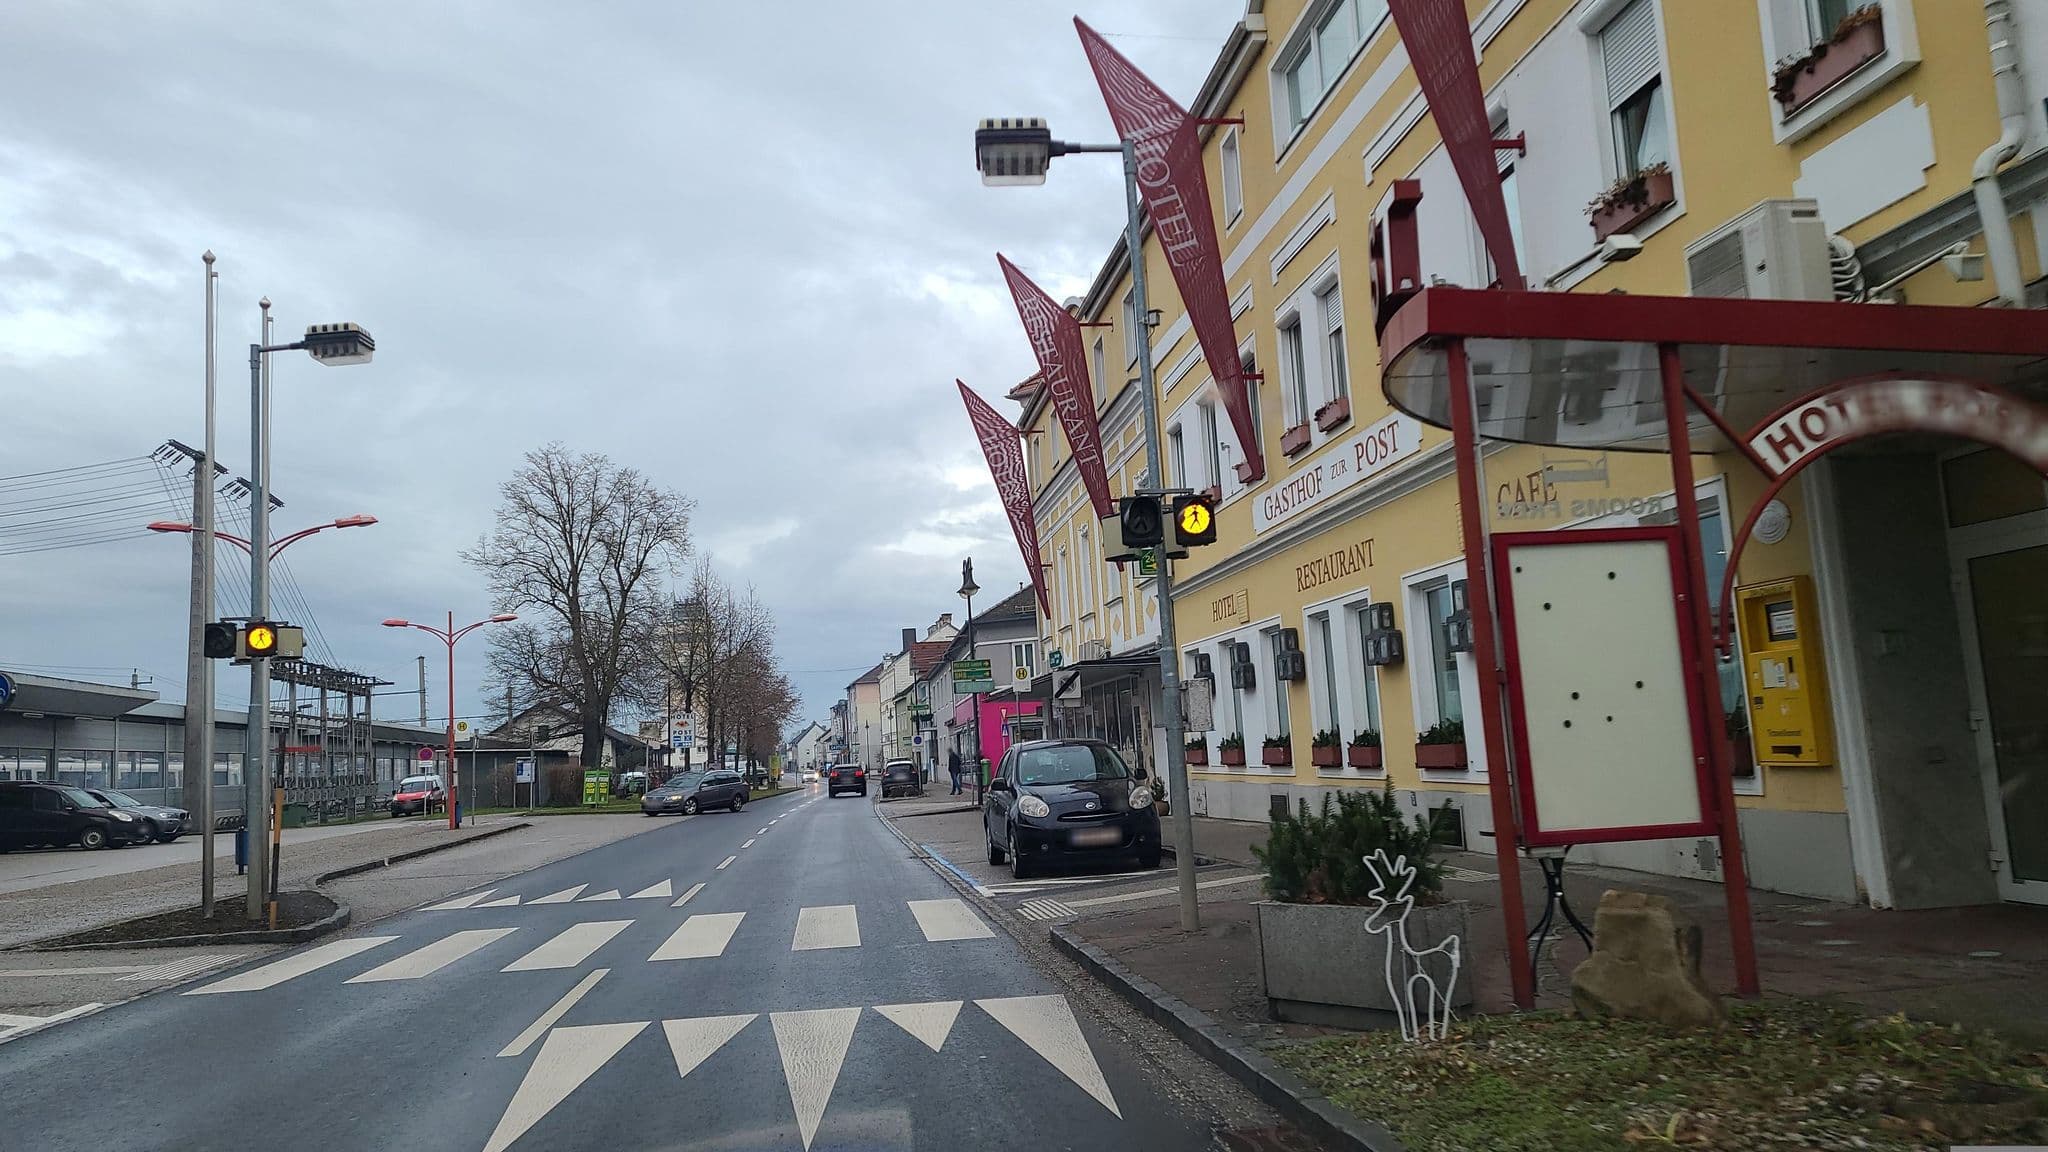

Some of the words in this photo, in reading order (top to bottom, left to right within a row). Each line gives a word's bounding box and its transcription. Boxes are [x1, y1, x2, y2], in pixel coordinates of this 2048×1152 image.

[1122, 124, 1200, 267] HOTEL
[1020, 295, 1100, 465] RESTAURANT
[1263, 465, 1324, 521] GASTHOF
[1330, 459, 1348, 481] ZUR
[1354, 420, 1399, 472] POST
[1211, 594, 1237, 622] HOTEL
[1296, 538, 1375, 593] RESTAURANT
